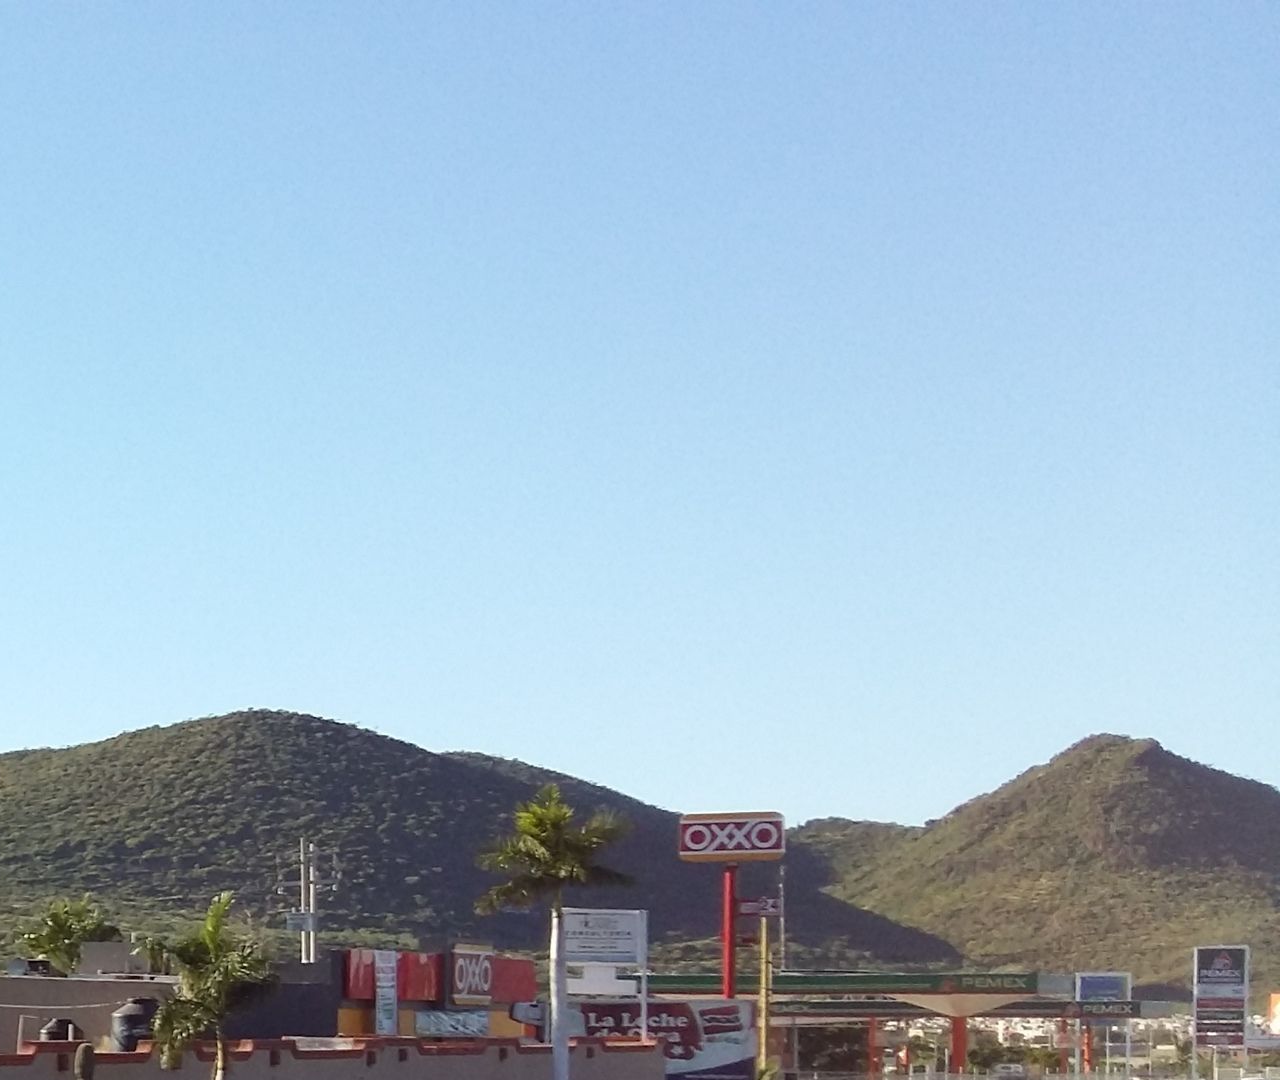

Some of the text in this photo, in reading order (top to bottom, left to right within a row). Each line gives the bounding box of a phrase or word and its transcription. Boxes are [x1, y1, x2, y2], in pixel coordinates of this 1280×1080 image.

[685, 820, 777, 852] OXXO
[455, 954, 491, 996] OXXO
[962, 977, 1026, 988] PEMEX
[1083, 1004, 1132, 1014] PEMEX
[589, 1013, 615, 1027] La
[621, 1012, 688, 1027] Leche
